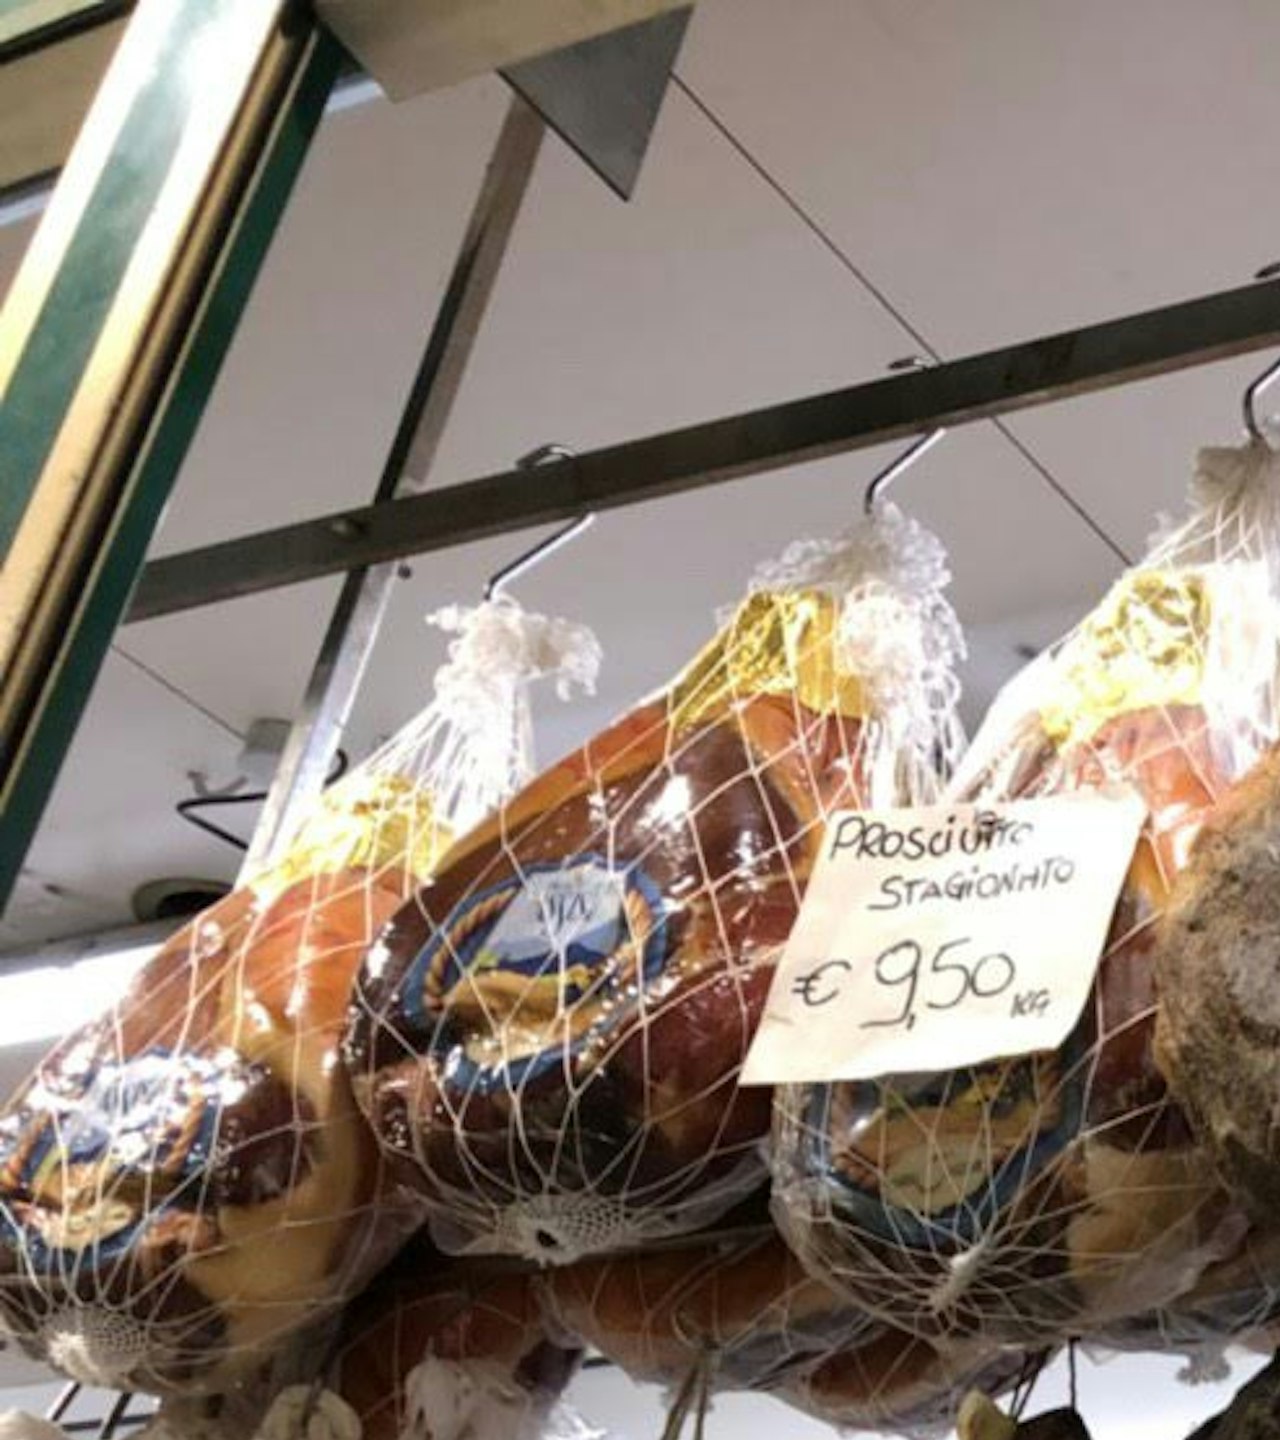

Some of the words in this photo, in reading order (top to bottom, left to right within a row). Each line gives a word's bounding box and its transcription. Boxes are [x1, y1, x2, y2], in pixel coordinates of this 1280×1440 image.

[868, 856, 1074, 910] STAGIONATO
[792, 960, 852, 1006] €
[860, 938, 1016, 1030] 9,50
